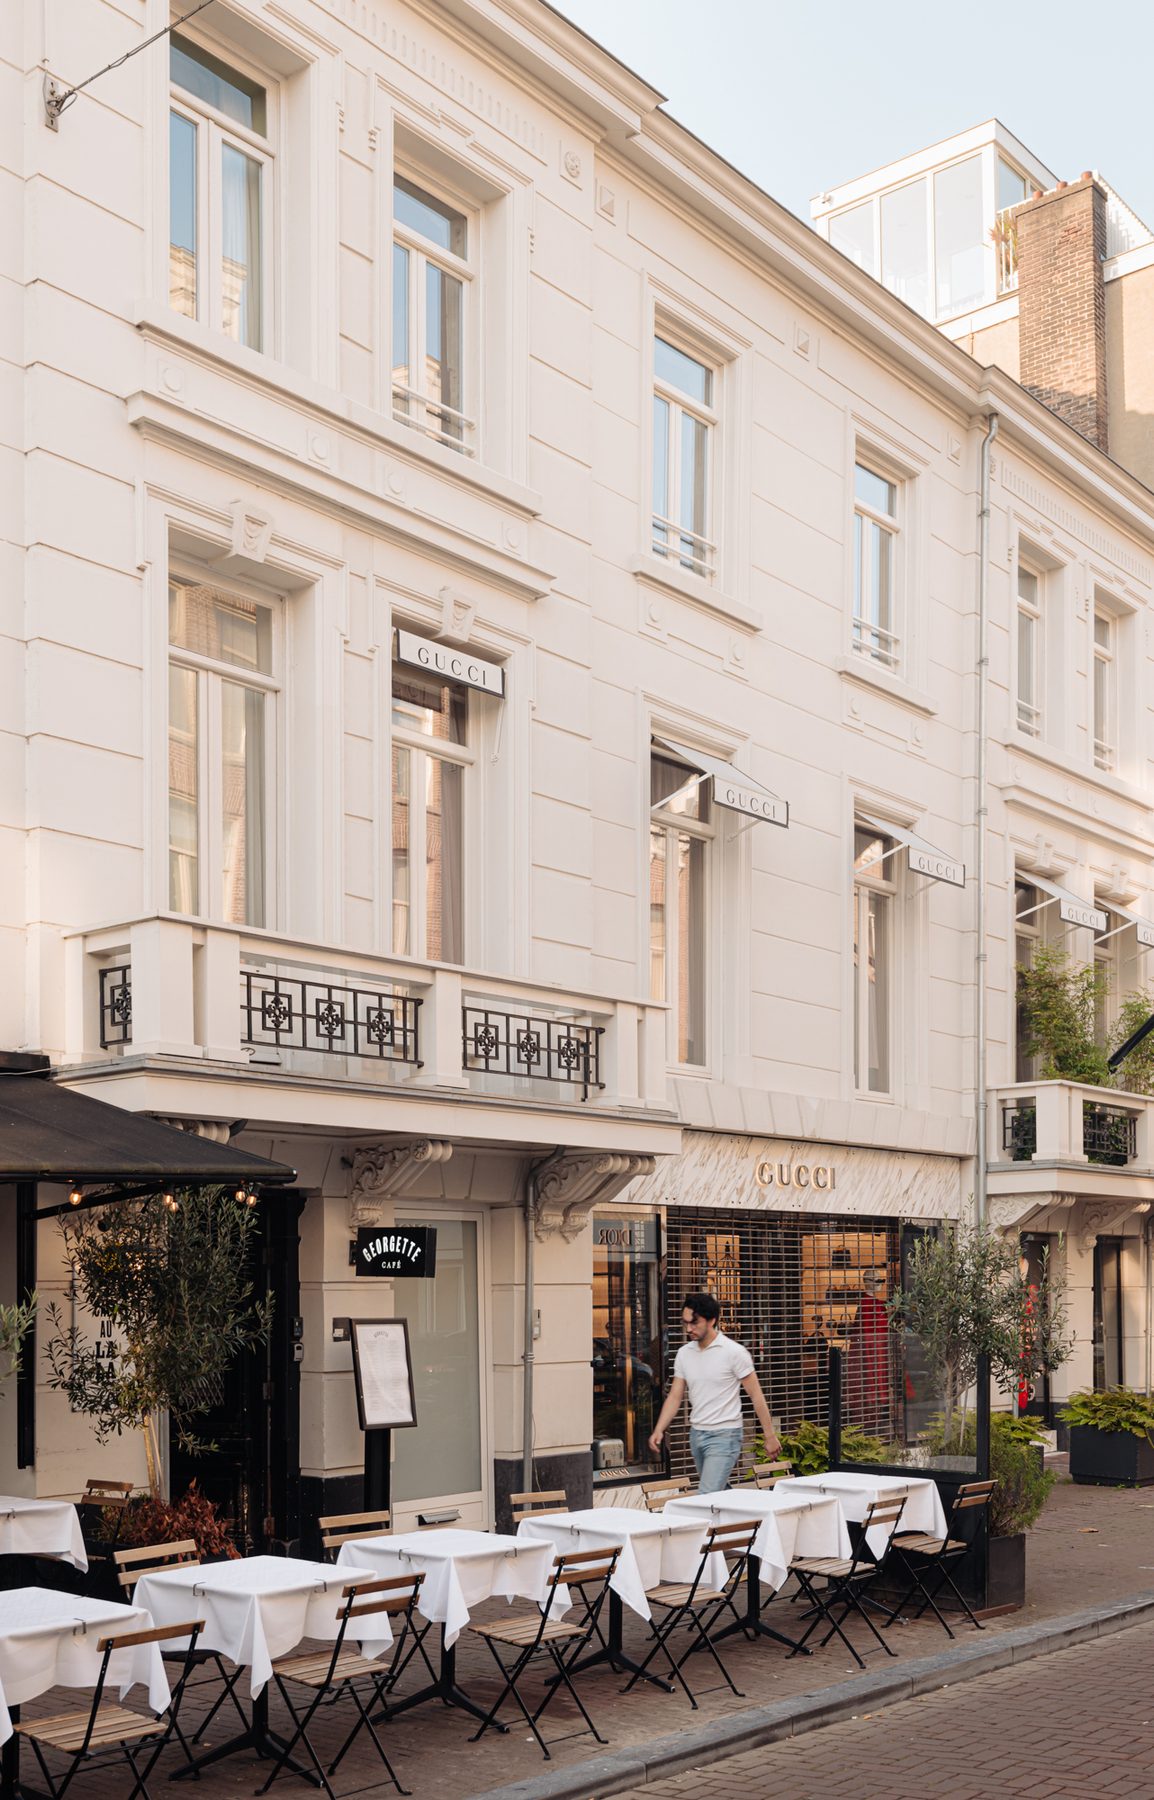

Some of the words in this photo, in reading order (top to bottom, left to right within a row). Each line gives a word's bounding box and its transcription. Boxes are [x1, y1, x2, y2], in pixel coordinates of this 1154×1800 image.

[418, 647, 486, 686] GUCCI
[726, 789, 776, 819] GUCCI
[918, 856, 956, 881] GUCCI
[1067, 907, 1099, 929] GUCCI
[756, 1162, 836, 1190] GUCCI
[362, 1235, 422, 1263] GEORGETTE
[381, 1260, 402, 1270] CAFÉ
[100, 1320, 112, 1338] AU
